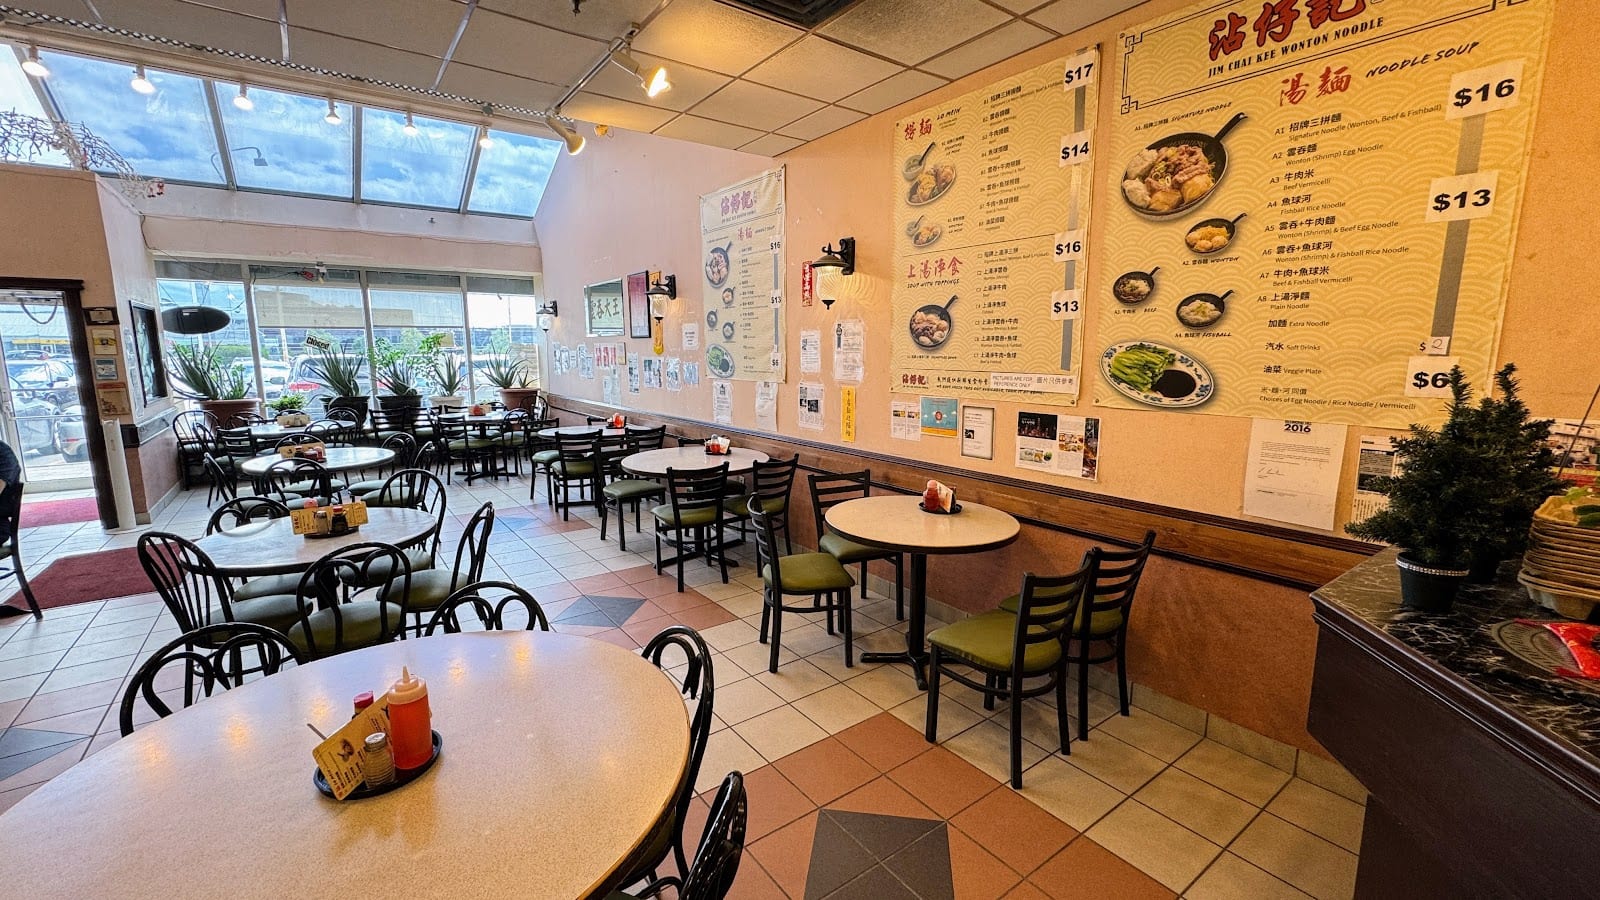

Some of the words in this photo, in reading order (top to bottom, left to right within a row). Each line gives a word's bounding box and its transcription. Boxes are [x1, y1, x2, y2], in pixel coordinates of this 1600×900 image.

[1208, 64, 1224, 78] JIM
[1228, 56, 1251, 71] CHAI
[1256, 49, 1276, 63] KEE
[1281, 36, 1329, 56] WONTON
[1334, 17, 1383, 40] NOODLE
[1366, 54, 1431, 78] NOODLE
[1436, 42, 1479, 62] SOUP
[1065, 63, 1093, 84] $17
[1453, 79, 1515, 108] $16
[1288, 131, 1319, 141] Signature
[1321, 124, 1345, 134] Noodle
[1347, 118, 1379, 130] (Wonton,
[1382, 113, 1399, 122] Beef
[1408, 104, 1442, 117] Fishball)
[1062, 142, 1089, 160] $14
[1272, 152, 1283, 160] A2
[1286, 157, 1310, 166] Wonton
[1313, 151, 1341, 162] (Shrimp)
[1357, 144, 1383, 153] Noodle
[1284, 169, 1314, 181] 牛肉米
[1298, 178, 1331, 187] Vermicelli
[1281, 194, 1312, 206] 魚球河
[1432, 189, 1491, 212] $13
[1280, 207, 1305, 215] Fishball
[1372, 220, 1398, 229] Noodle
[770, 242, 780, 250] $16
[1056, 241, 1081, 255] $16
[1301, 253, 1328, 261] (Shrimp)
[1337, 250, 1363, 258] Fishball
[1382, 246, 1409, 254] Noodle
[1274, 266, 1329, 278] 牛肉+魚球米
[1320, 276, 1352, 284] Vermicelli
[1053, 301, 1079, 313] $13
[1265, 342, 1284, 351] 汽水
[1419, 341, 1426, 352] $
[1432, 339, 1443, 349] 2
[1264, 365, 1282, 373] 油菜
[1285, 424, 1311, 433] 2016
